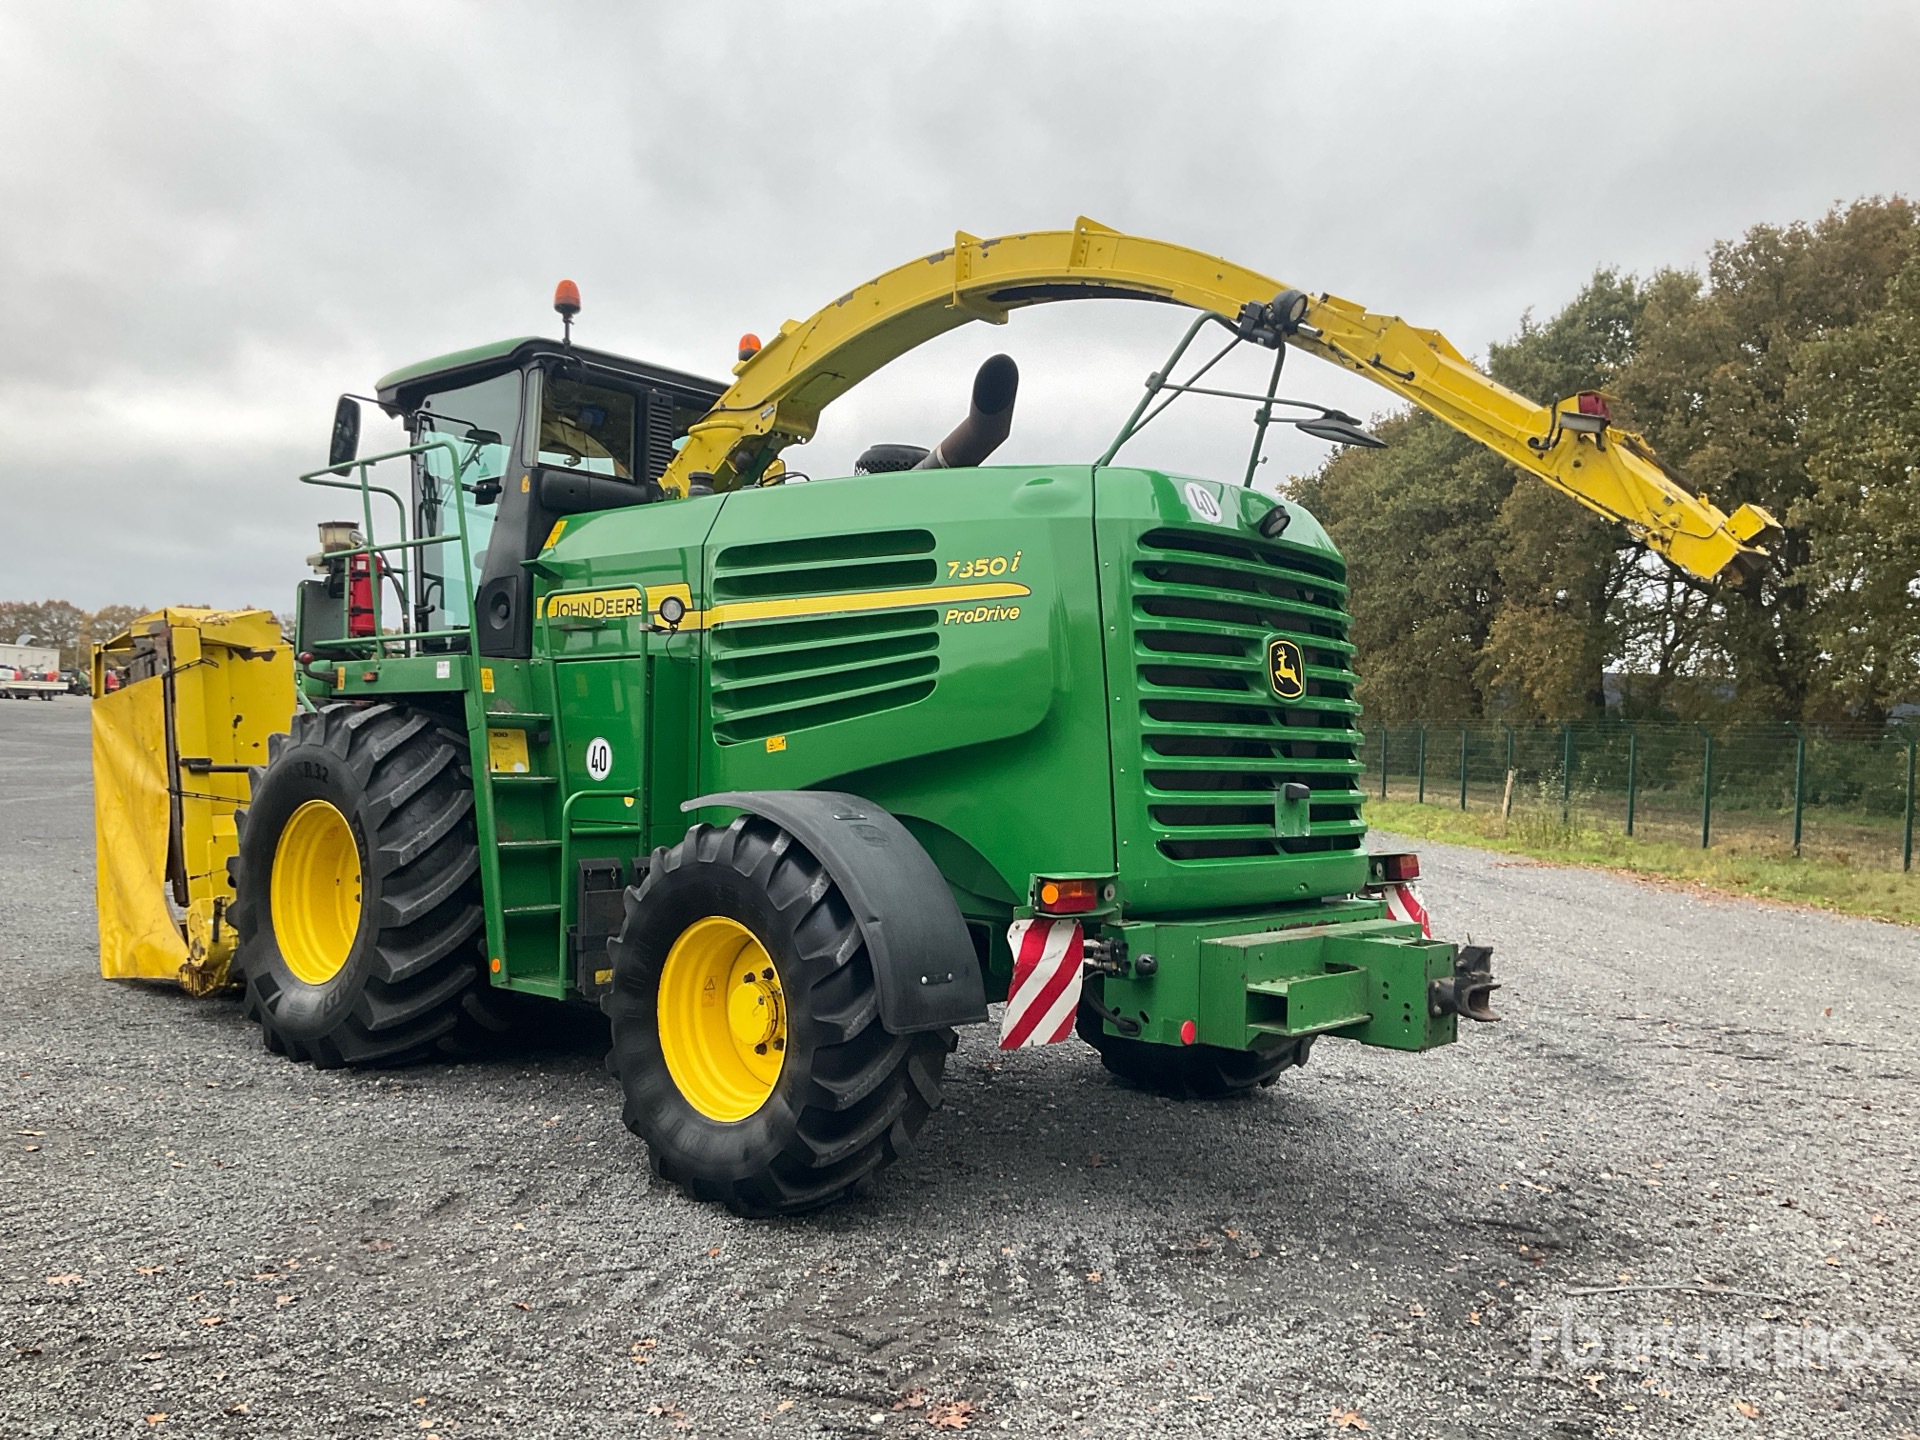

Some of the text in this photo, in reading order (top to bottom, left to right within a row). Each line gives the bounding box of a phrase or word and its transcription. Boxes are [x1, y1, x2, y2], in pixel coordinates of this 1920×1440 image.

[1190, 487, 1218, 517] 40
[551, 597, 642, 618] JOHN DEERE
[943, 605, 1021, 625] ProDrive
[591, 745, 607, 772] 40
